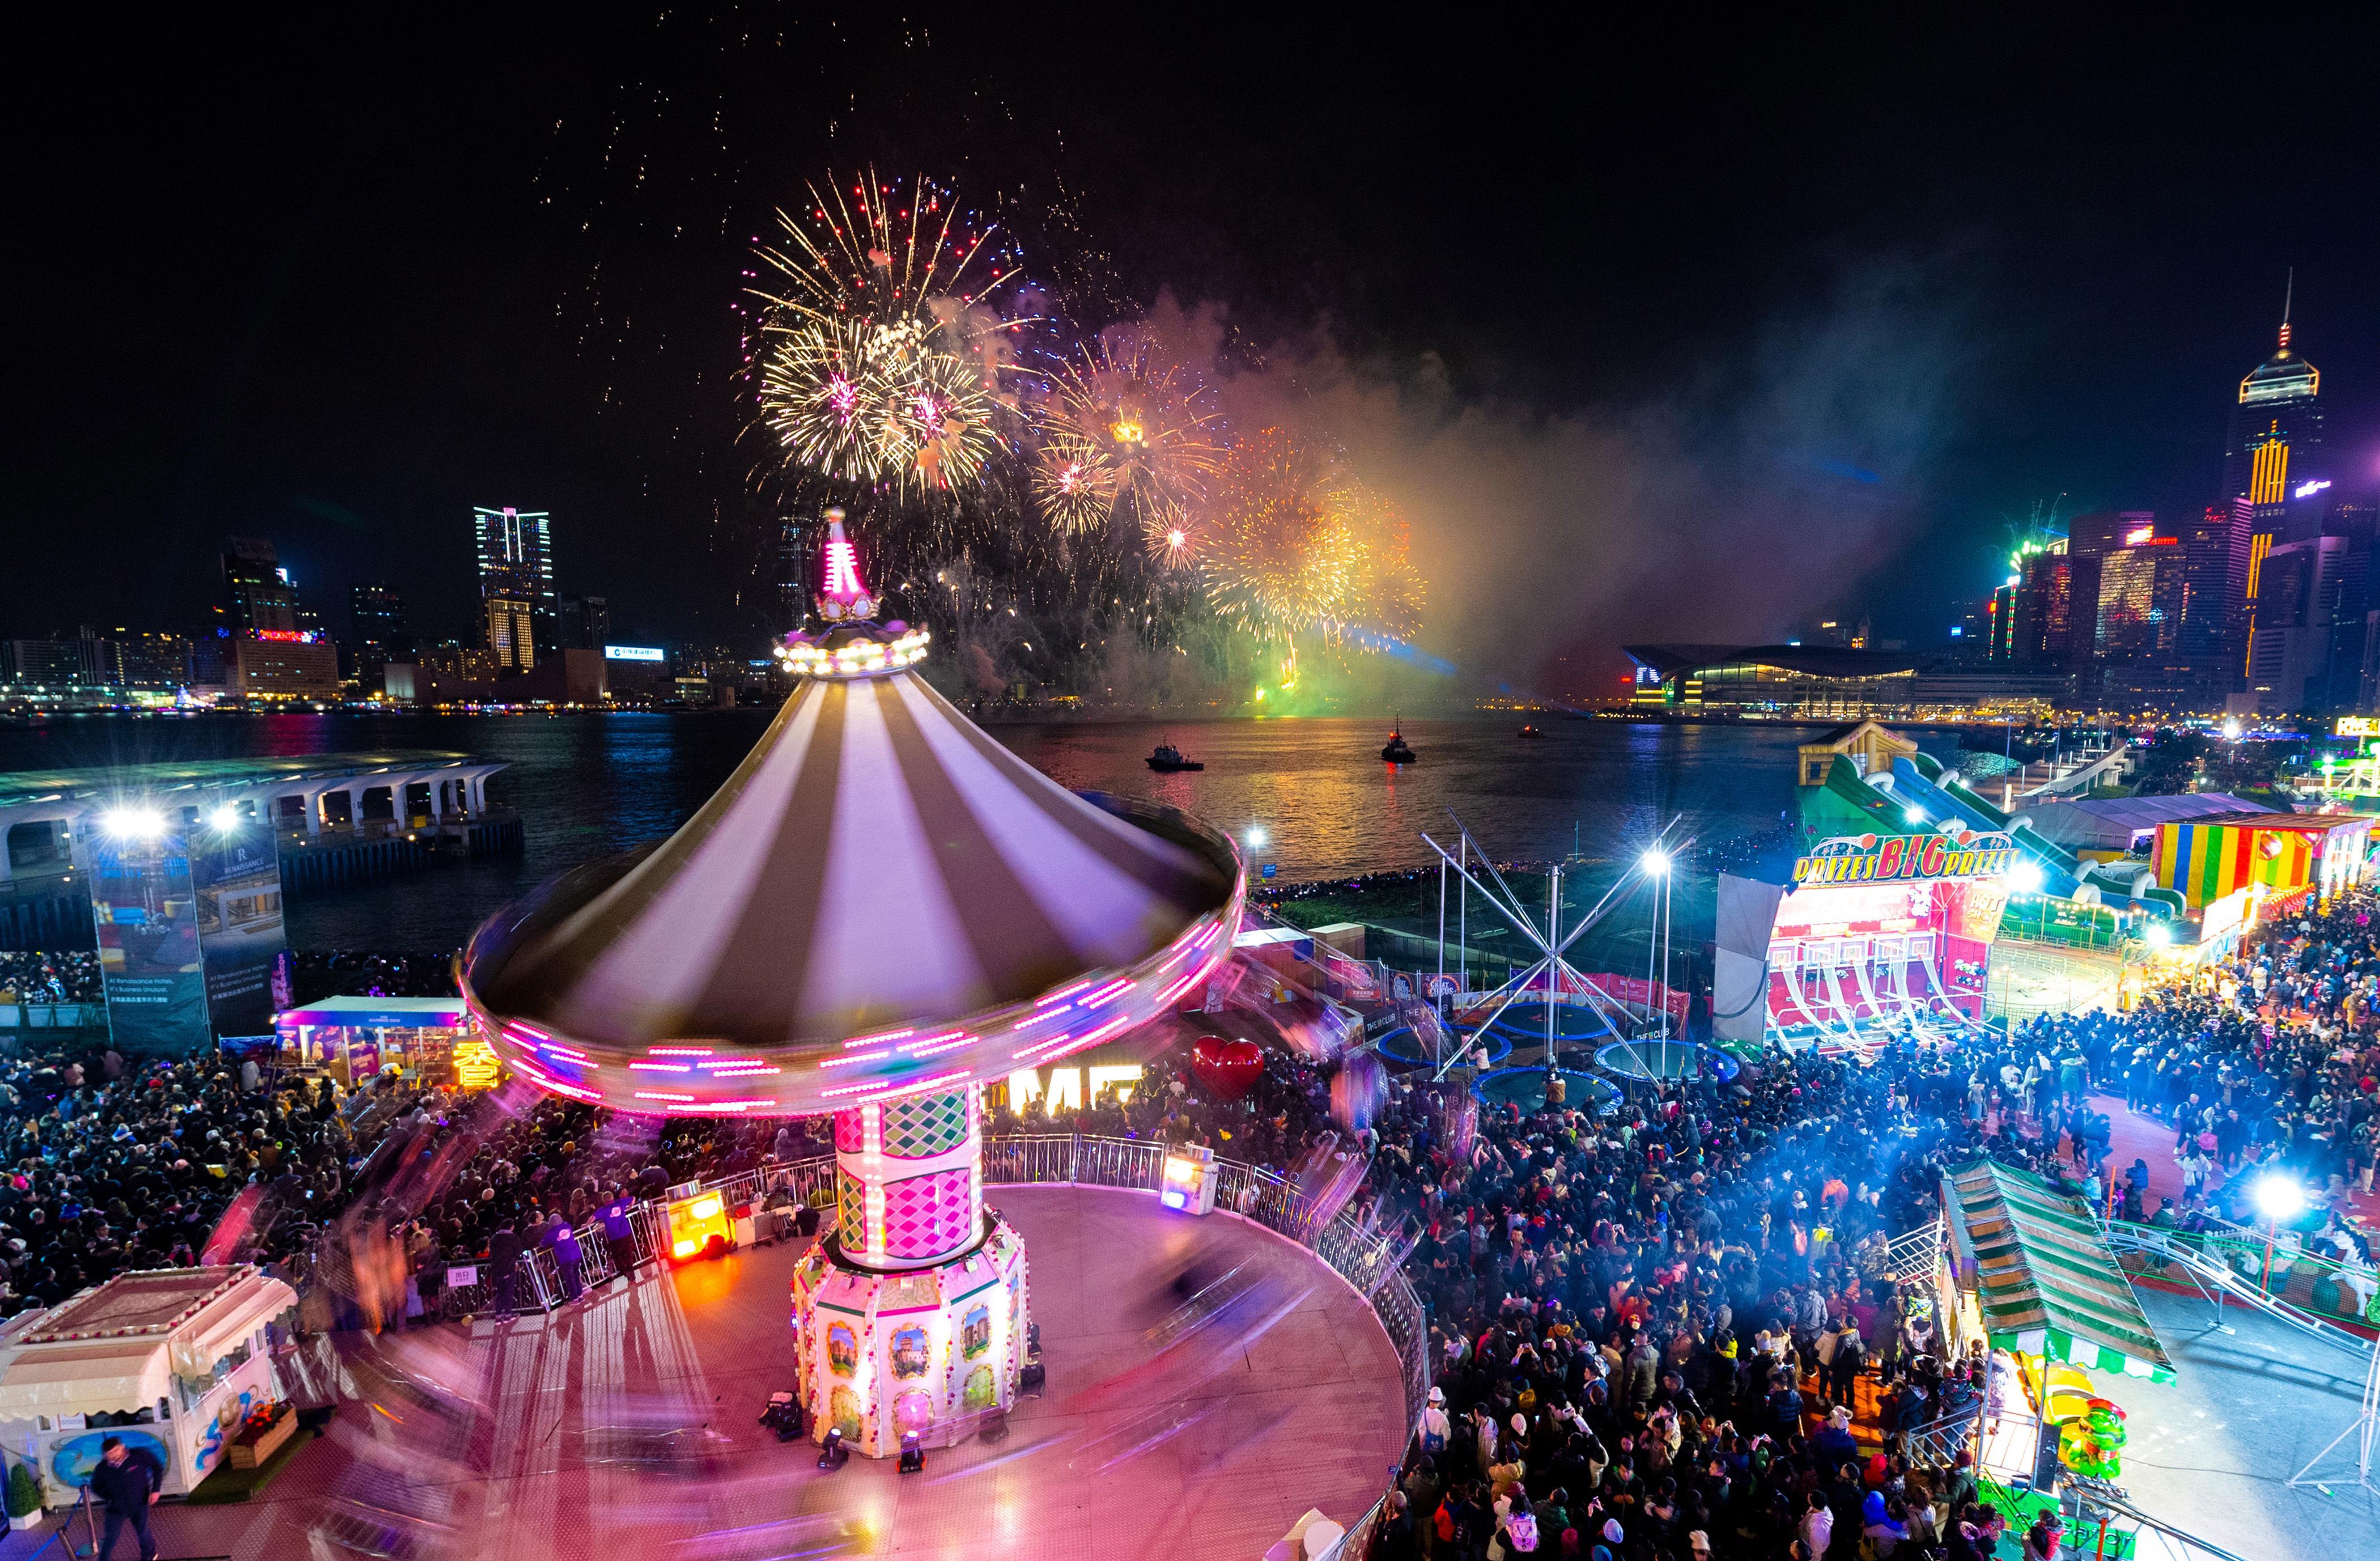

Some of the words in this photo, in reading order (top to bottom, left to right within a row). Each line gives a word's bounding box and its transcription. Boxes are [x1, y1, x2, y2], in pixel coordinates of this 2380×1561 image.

[1794, 855, 1877, 883] PRIZES
[1876, 834, 1948, 879] BIG
[1943, 849, 2021, 877] PRIZES
[1970, 893, 2005, 913] HOT
[1430, 980, 1450, 989] GRAT
[1430, 987, 1454, 998] CICUS
[1404, 1008, 1420, 1017] THE
[1427, 1004, 1448, 1014] CLB
[1366, 1020, 1378, 1032] THE
[1382, 1012, 1396, 1026] CLUB
[1636, 1032, 1648, 1041] THE
